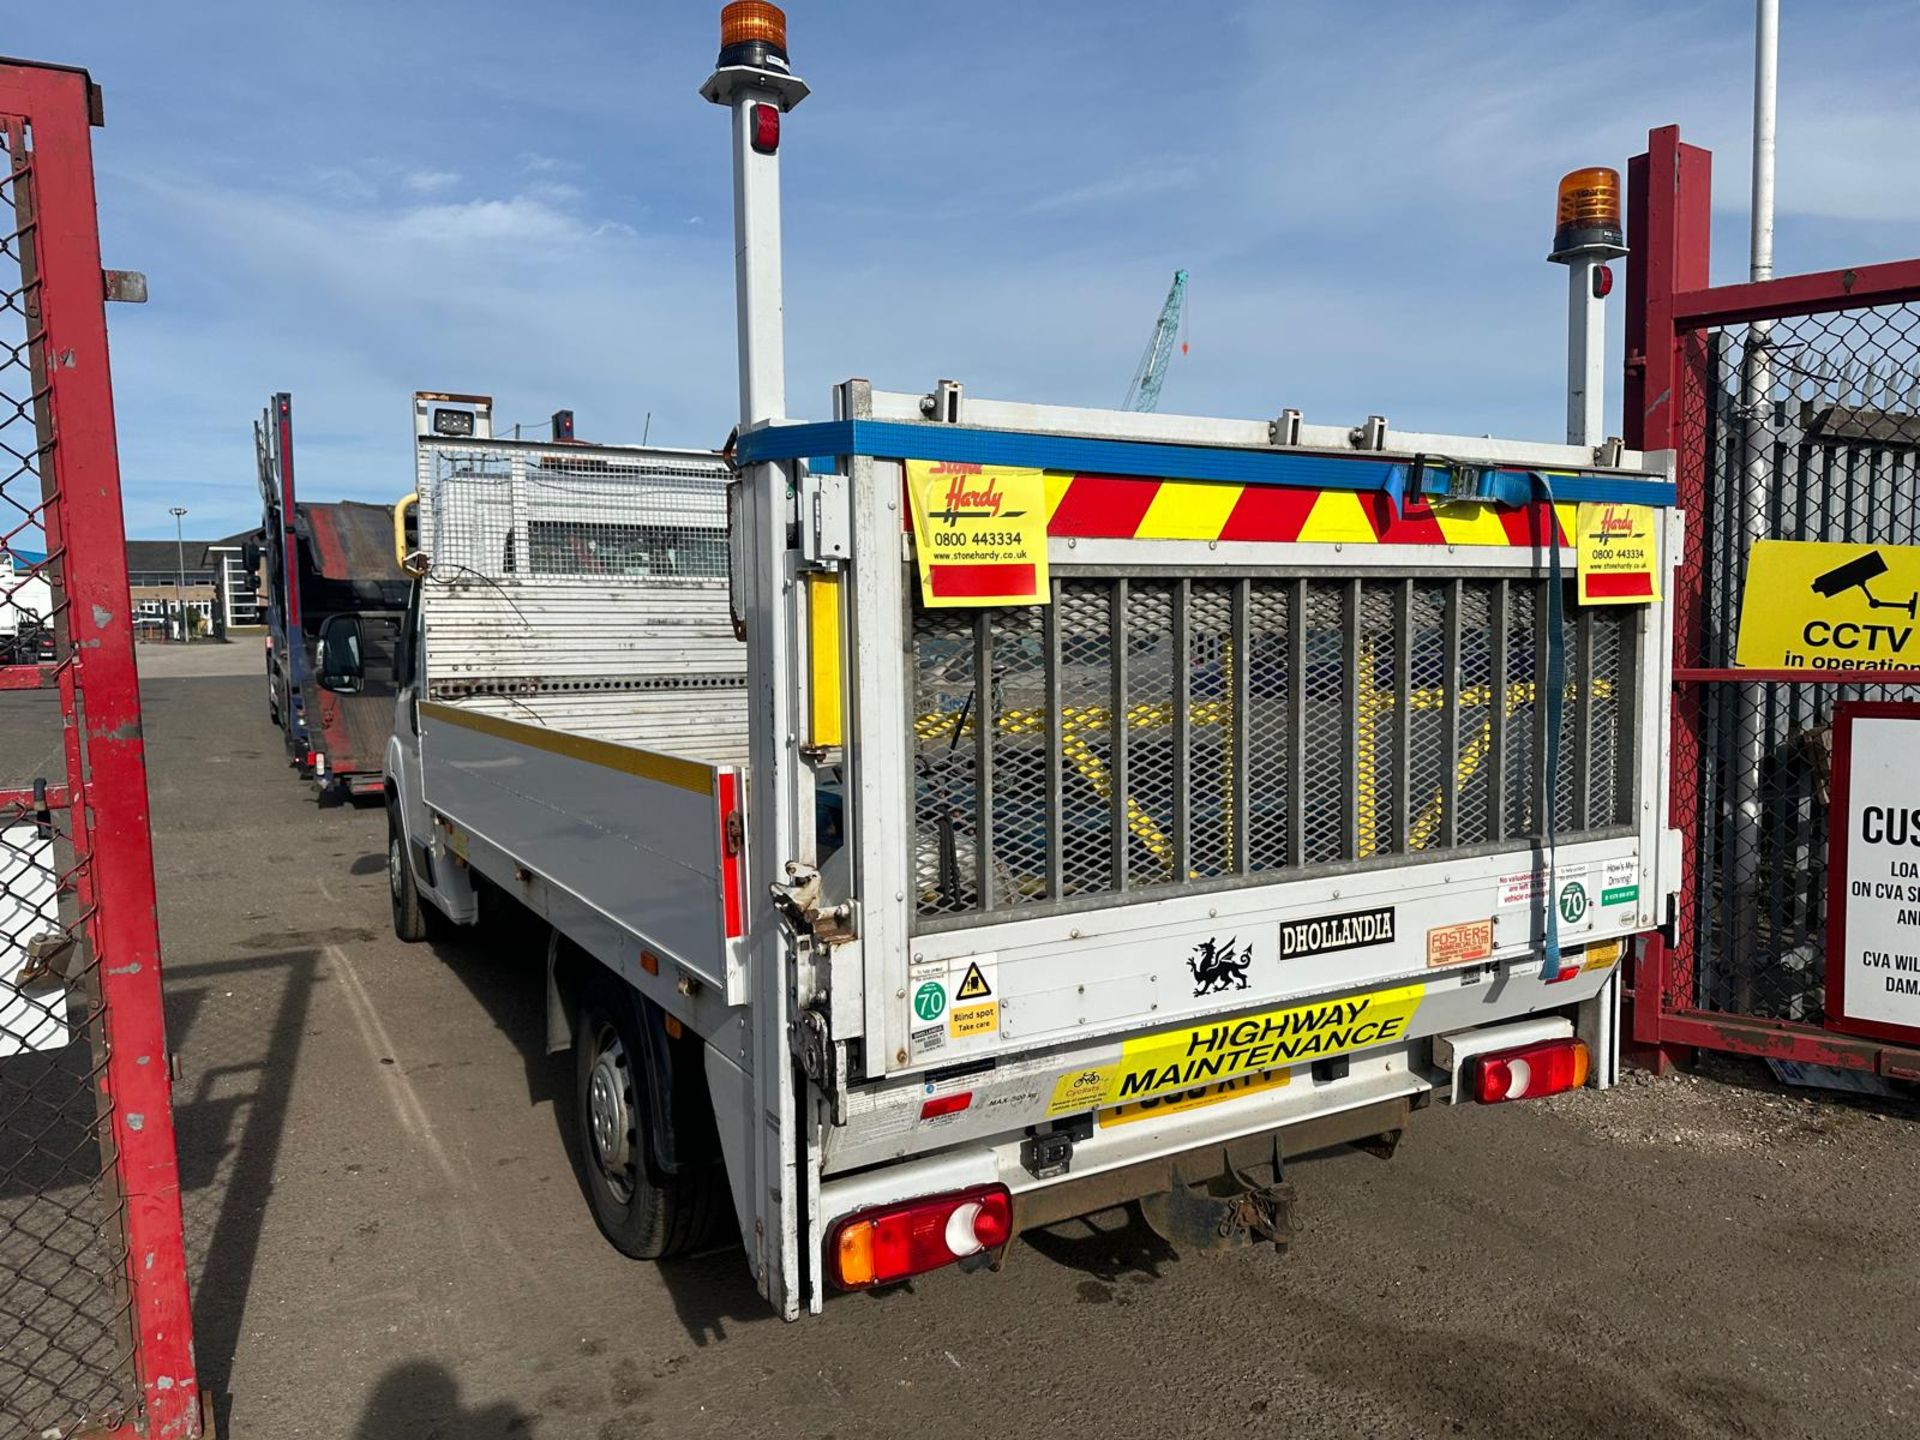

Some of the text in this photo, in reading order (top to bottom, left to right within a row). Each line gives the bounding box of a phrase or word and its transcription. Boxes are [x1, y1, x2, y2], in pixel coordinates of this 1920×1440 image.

[944, 475, 1004, 518] Hardy
[1601, 506, 1633, 538] Hardy
[935, 532, 1022, 546] 0800 443334
[933, 550, 1027, 561] www.stonehardy.co.uk
[1592, 549, 1644, 560] 0800 443334
[1803, 621, 1913, 653] CCTV
[1784, 650, 1804, 667] in
[1852, 880, 1871, 897] ON
[1875, 883, 1903, 901] CVA
[1562, 892, 1584, 917] 70
[1897, 909, 1920, 926] AN
[1283, 912, 1392, 955] DHOLLANDIA
[1432, 925, 1489, 946] FOSTERS
[1863, 951, 1890, 969] CVA
[918, 991, 942, 1016] 70
[954, 1008, 994, 1022] Blind spot
[959, 1021, 990, 1032] Take care
[1187, 999, 1370, 1057] HIGHWAY
[1119, 1017, 1404, 1097] MAINTENANCE
[990, 1097, 1009, 1106] MAX
